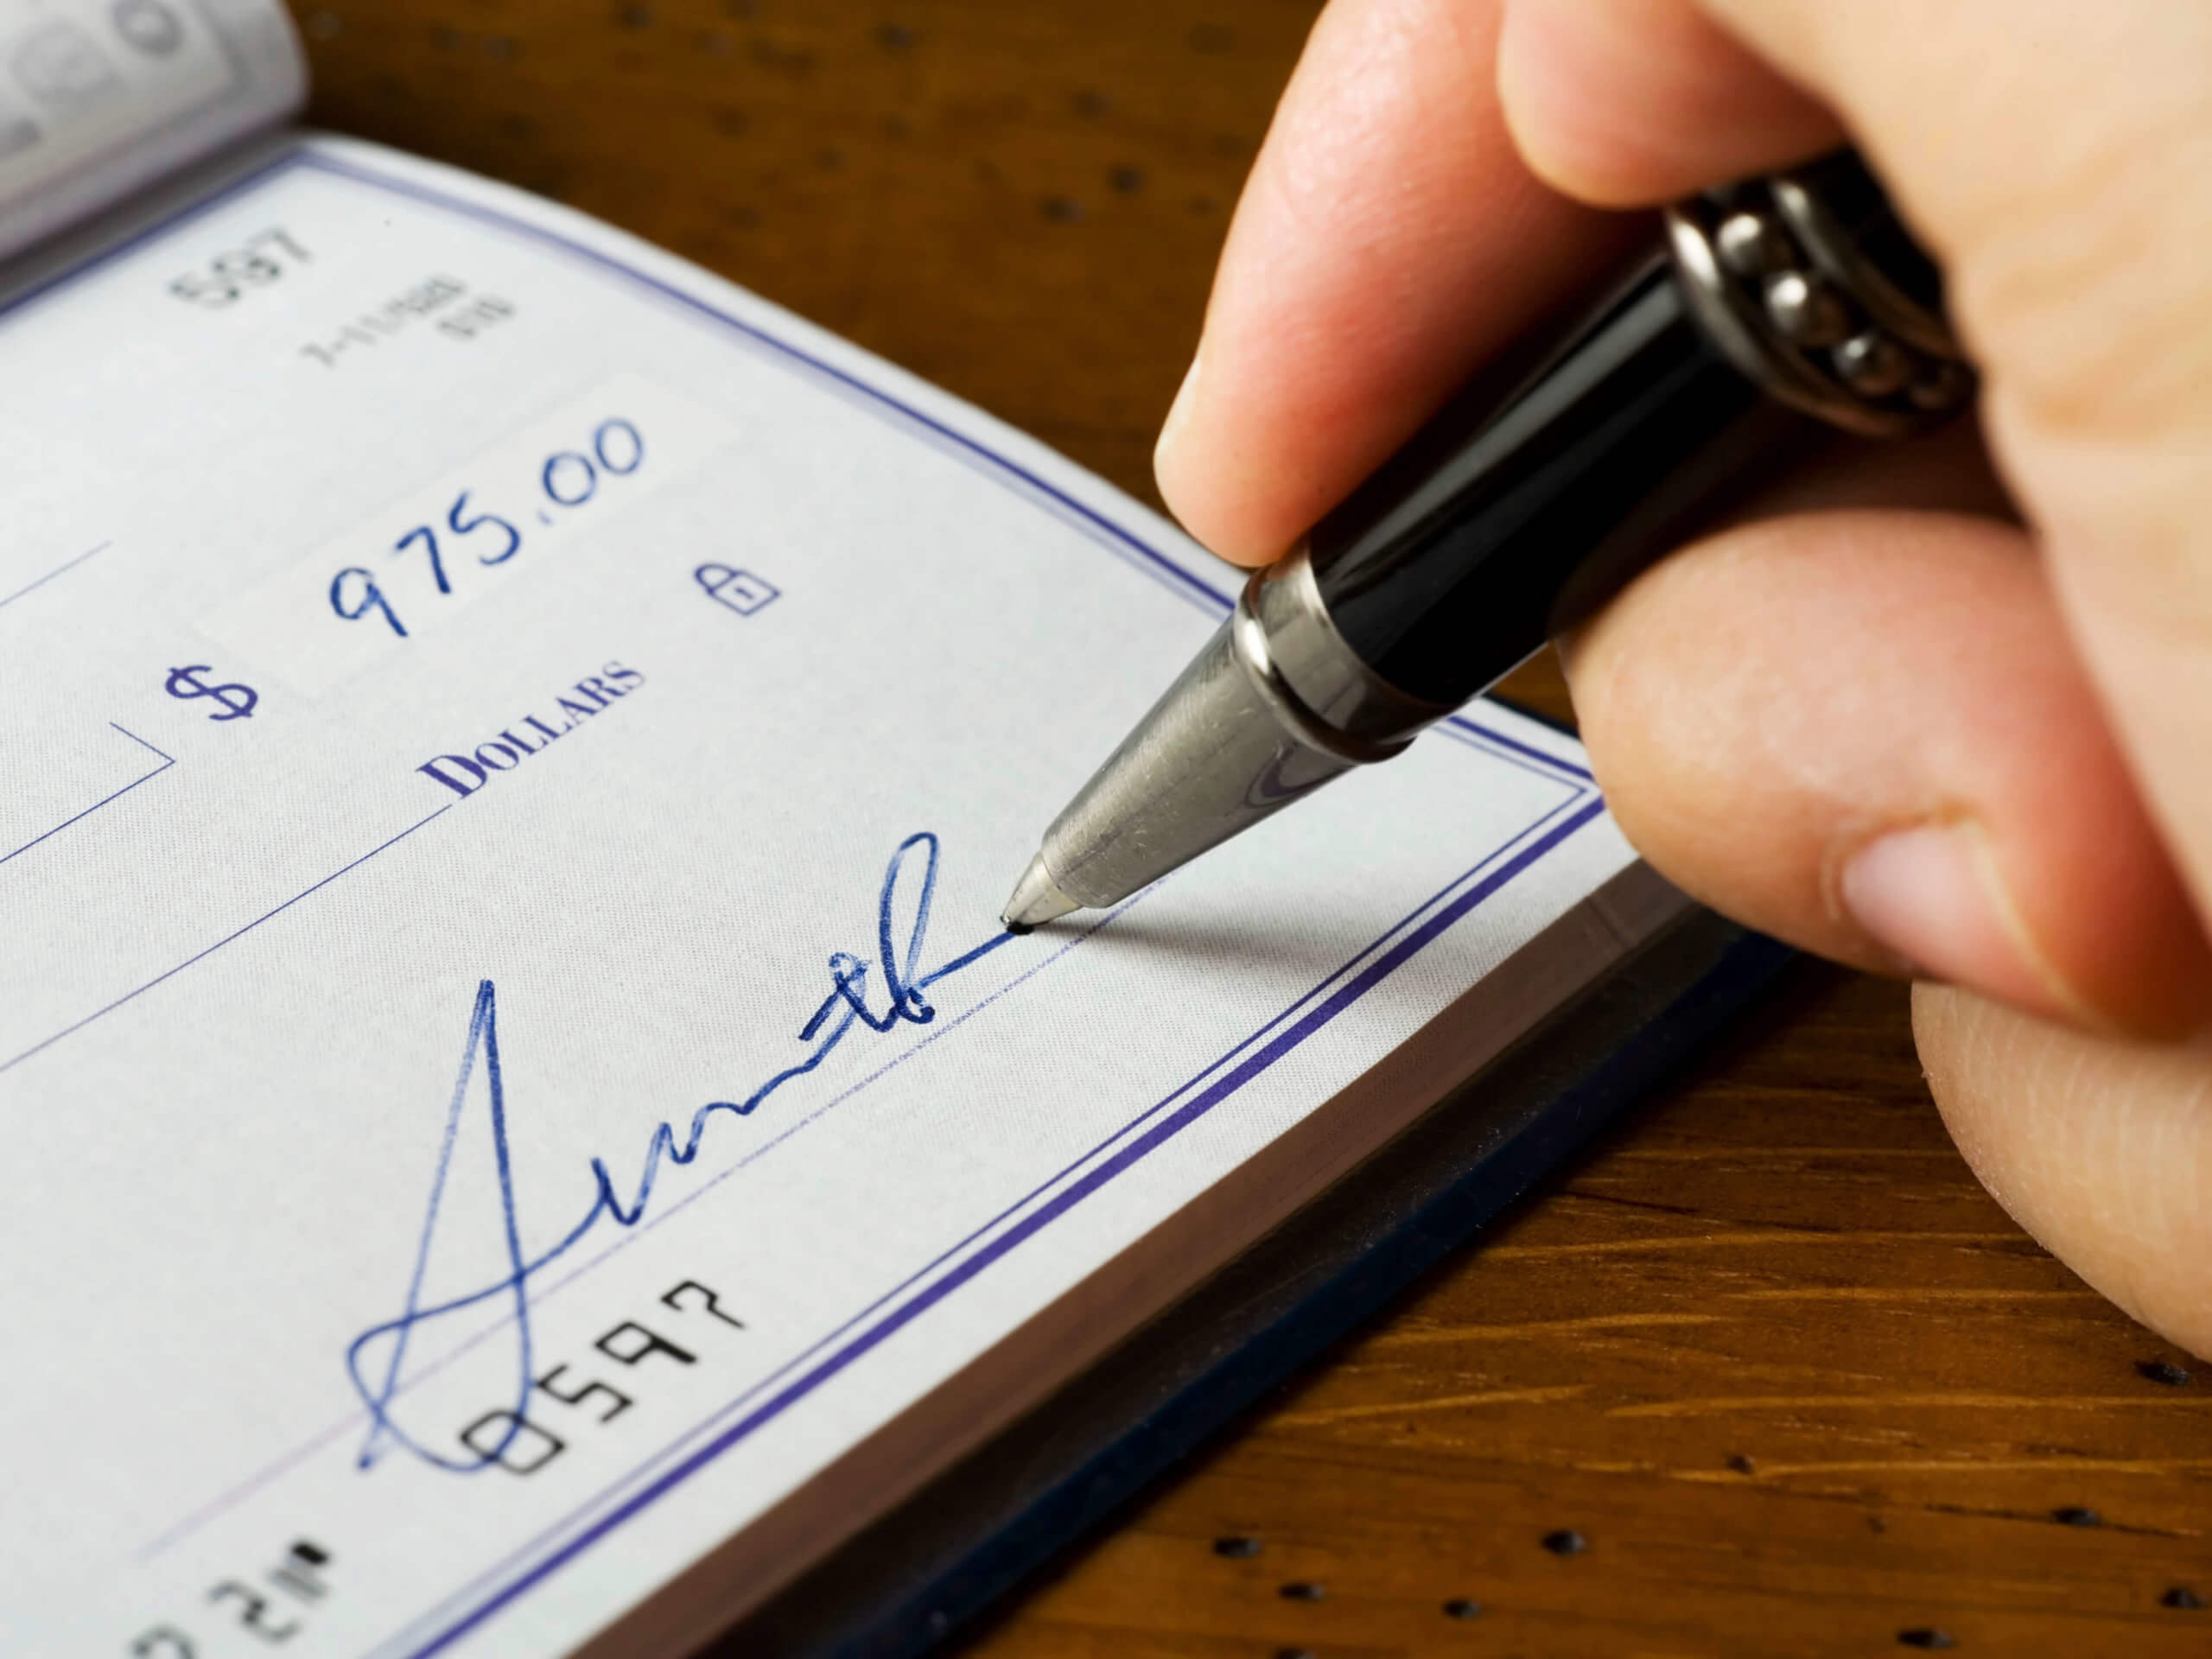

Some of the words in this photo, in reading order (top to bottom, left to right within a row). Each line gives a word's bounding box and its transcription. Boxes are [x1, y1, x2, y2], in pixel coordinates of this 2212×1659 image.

[167, 226, 312, 309] 597
[327, 416, 645, 639] 975.00
[164, 664, 259, 722] $
[415, 660, 645, 799] DOLLARS
[458, 1280, 746, 1474] 0597
